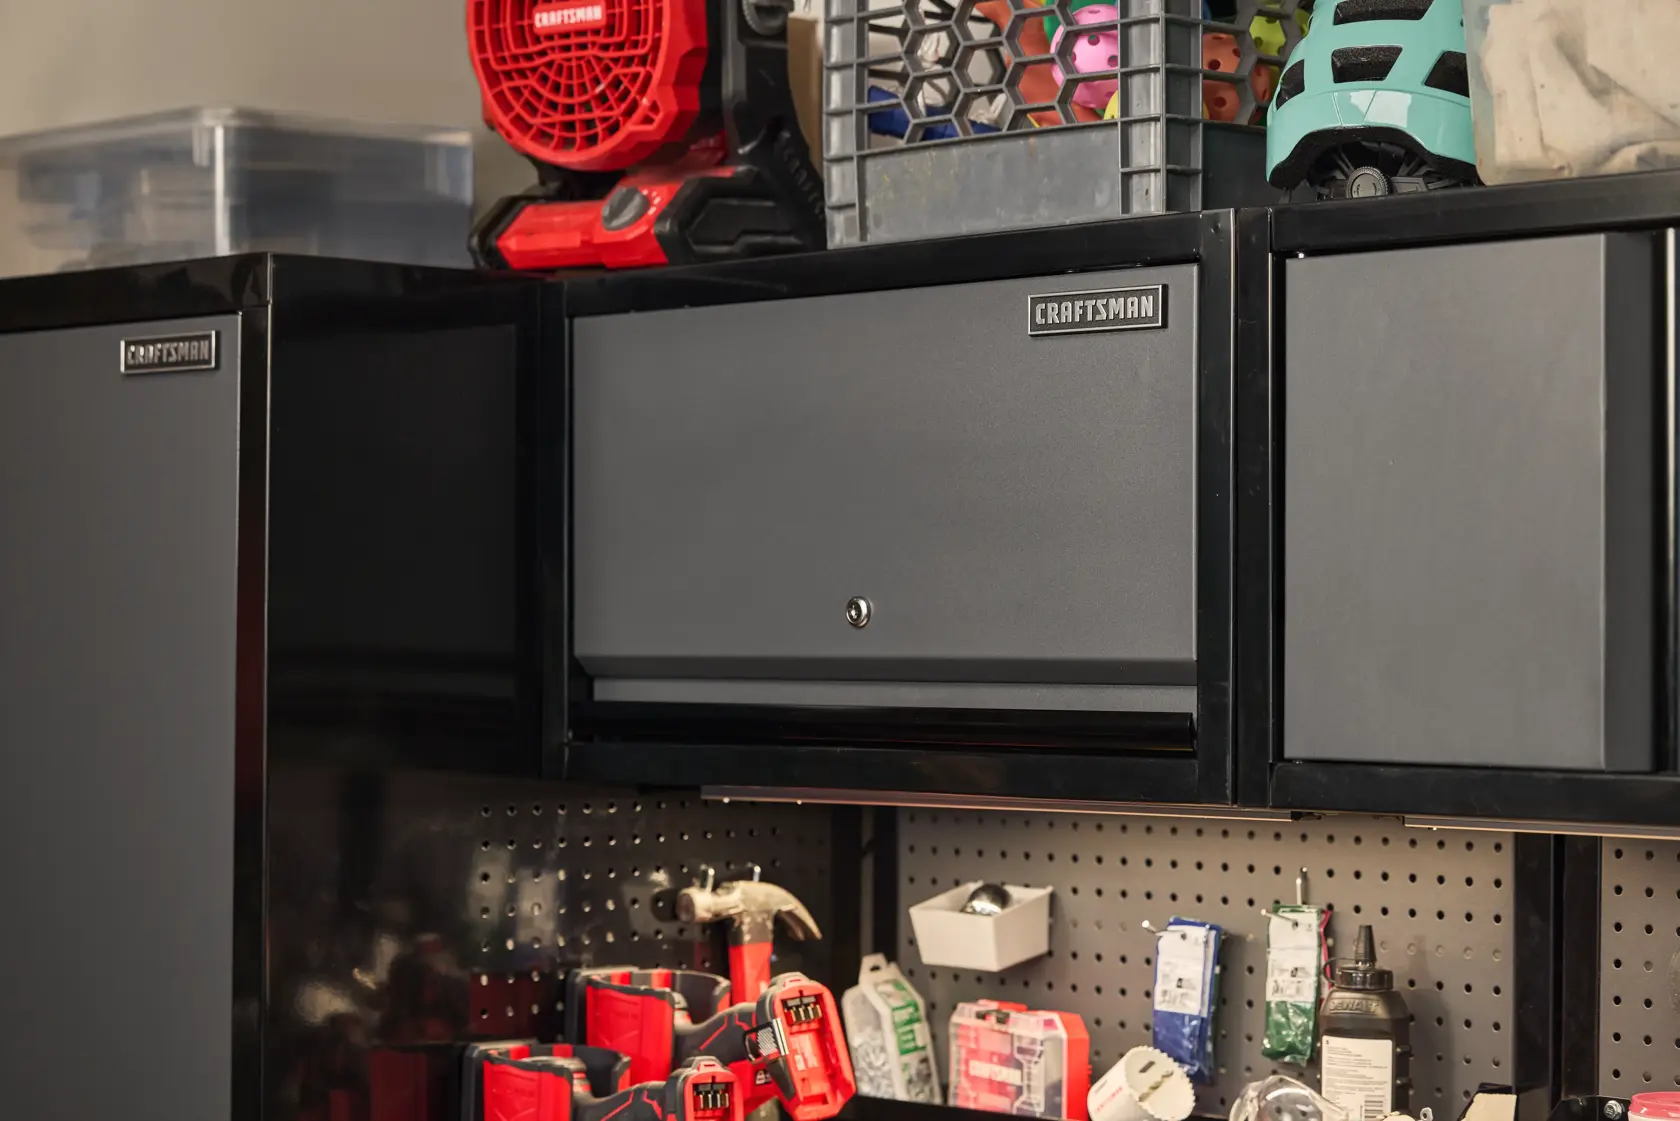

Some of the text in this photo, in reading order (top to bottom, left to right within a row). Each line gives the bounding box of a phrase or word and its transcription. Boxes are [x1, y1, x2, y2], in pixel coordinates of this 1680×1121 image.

[535, 5, 602, 28] CRAFTSMAN
[1035, 295, 1154, 325] CRAFTSMAN
[127, 339, 209, 365] CRAFTSMAN
